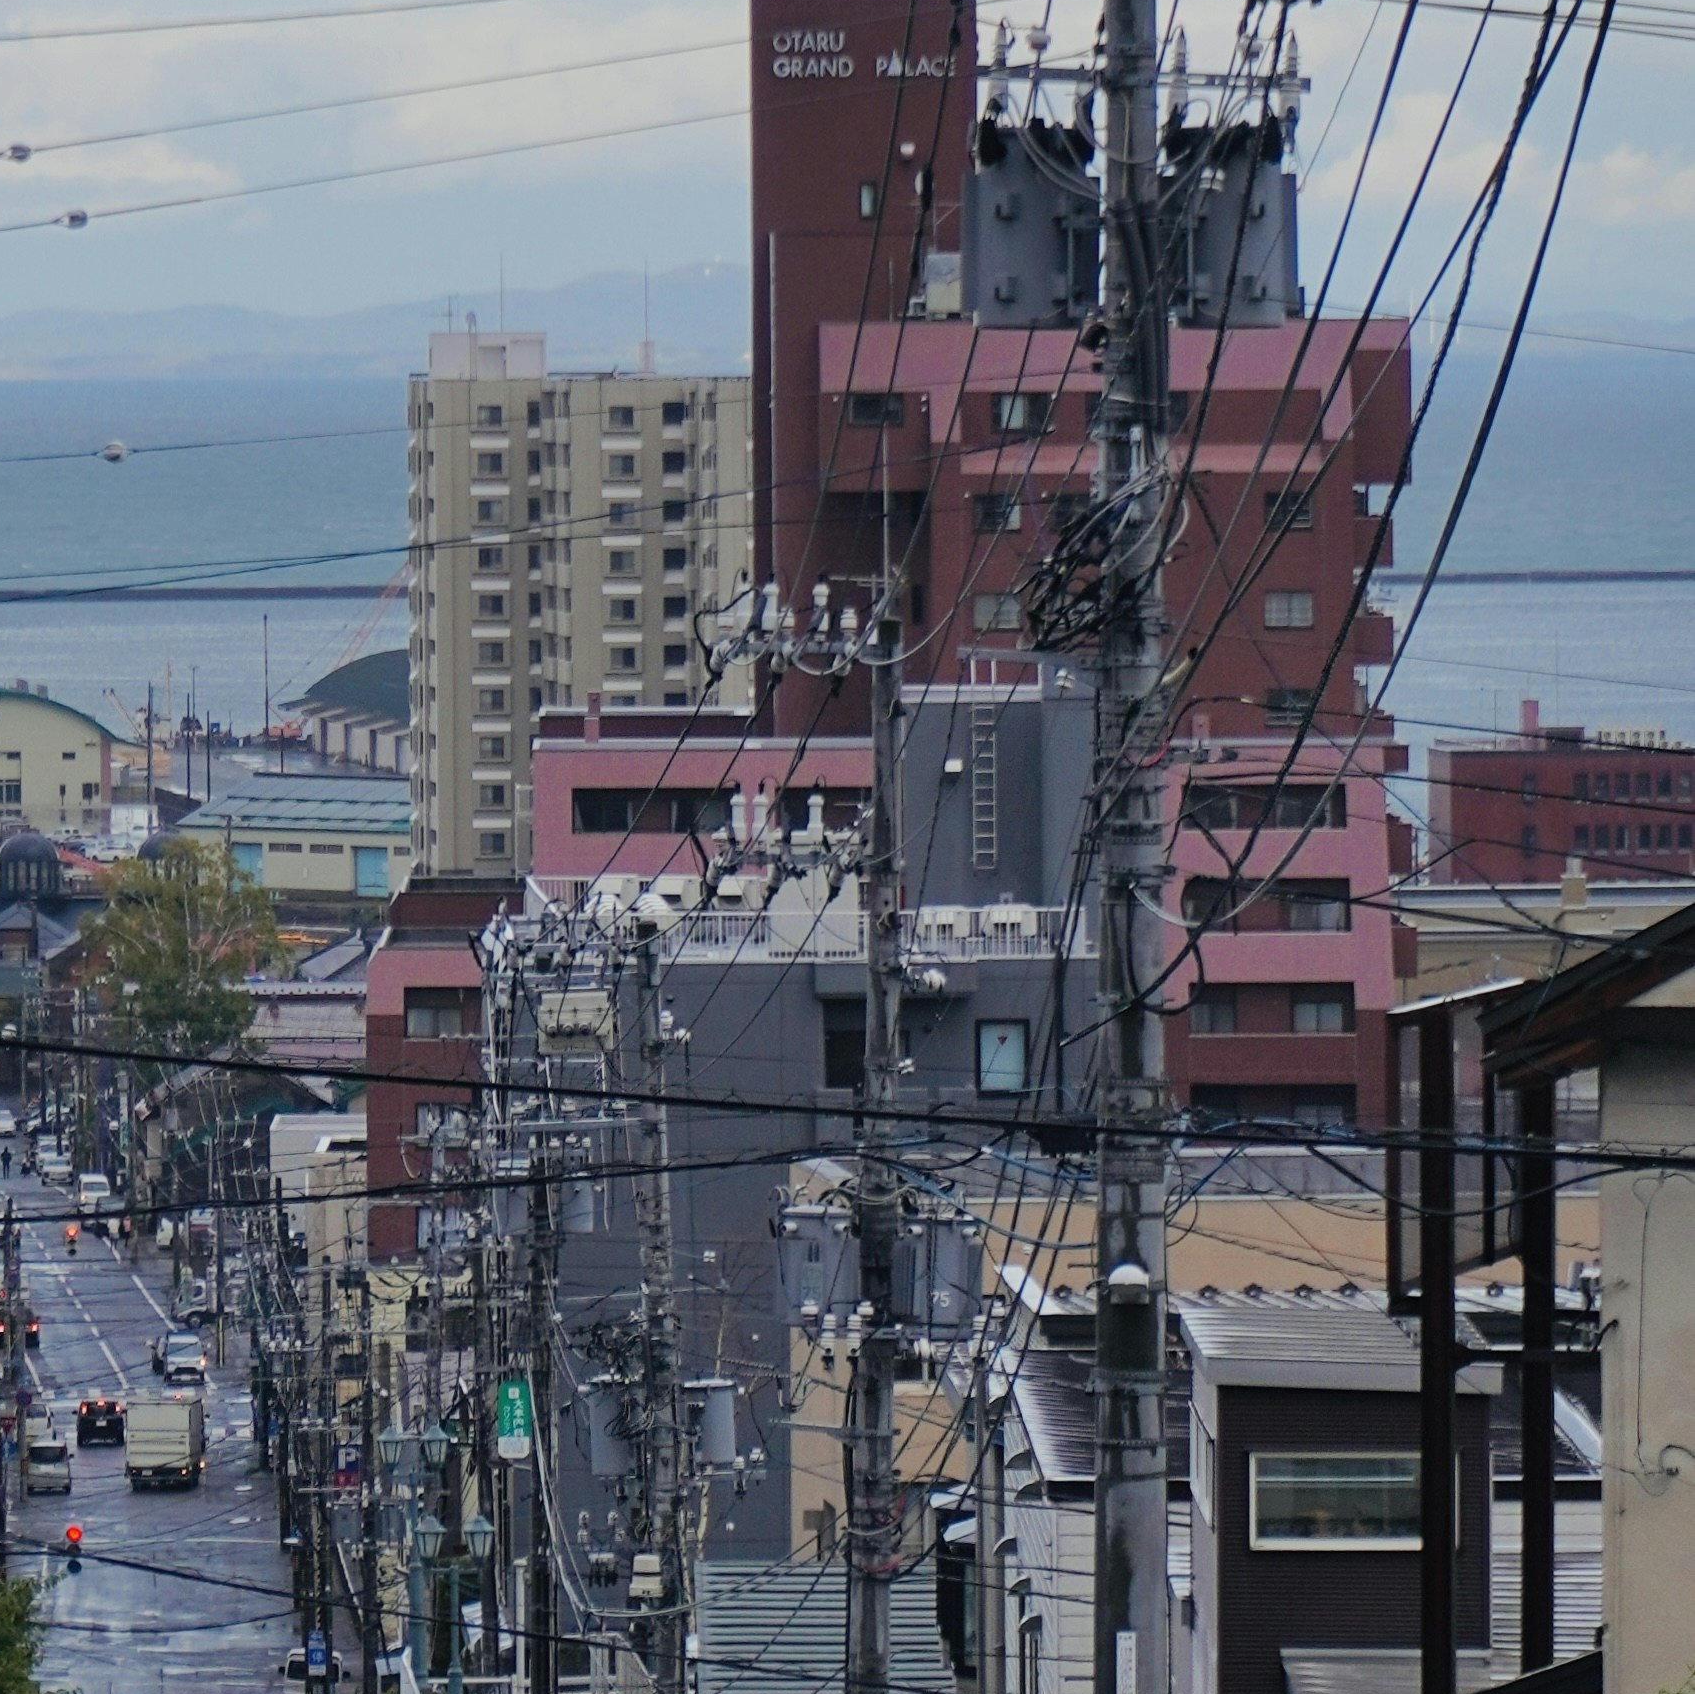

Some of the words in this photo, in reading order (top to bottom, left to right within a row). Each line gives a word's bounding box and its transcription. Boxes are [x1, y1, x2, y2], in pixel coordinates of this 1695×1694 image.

[773, 30, 845, 53] OTARU
[773, 56, 855, 79] GRAND
[876, 51, 956, 78] PALACE
[931, 1291, 951, 1308] 75
